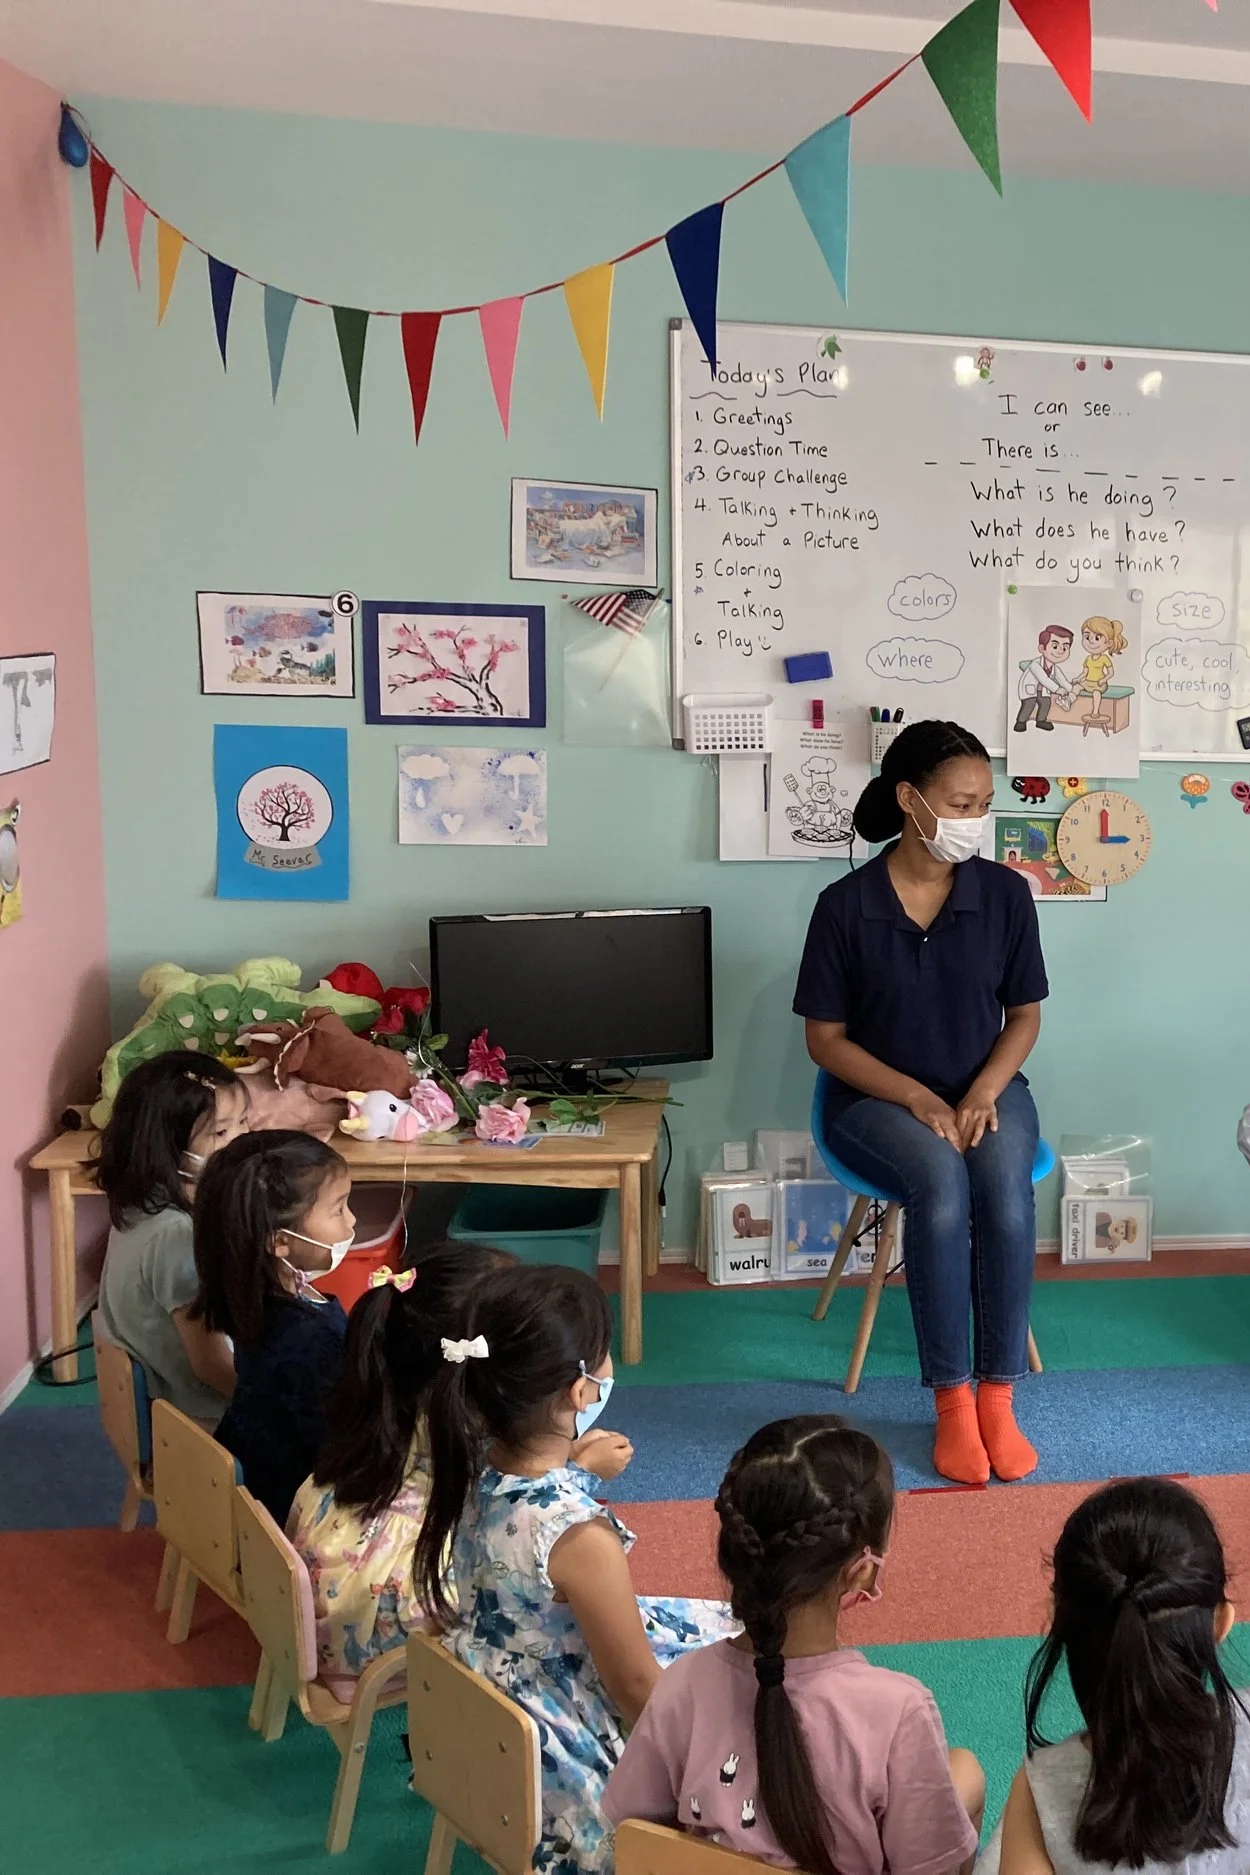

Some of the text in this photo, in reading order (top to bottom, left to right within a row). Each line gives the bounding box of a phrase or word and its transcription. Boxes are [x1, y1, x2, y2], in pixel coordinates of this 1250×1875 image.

[700, 359, 841, 398] Today's Plan
[997, 393, 1018, 415] I
[1034, 401, 1068, 415] can
[713, 406, 793, 436] Greetings
[1043, 422, 1061, 434] or
[693, 438, 828, 458] 2. Question Time
[981, 437, 1033, 458] There
[693, 465, 848, 493] 3. Group Challenge
[970, 479, 1026, 503] What
[1038, 486, 1054, 502] is
[1068, 484, 1088, 504] he
[694, 498, 711, 511] 4.
[718, 496, 778, 527] Talking
[801, 502, 879, 530] Thinking
[721, 529, 860, 550] About a Picture
[970, 518, 1024, 539] What
[1035, 520, 1075, 539] does
[1090, 522, 1110, 541] he
[714, 558, 782, 589] Coloring
[968, 548, 1025, 571] What
[1035, 549, 1059, 570] do
[1066, 557, 1103, 584] you
[337, 593, 354, 613] 6
[899, 587, 952, 606] colors
[717, 600, 784, 630] Talking
[1172, 603, 1212, 619] size
[717, 629, 753, 657] Play
[877, 648, 933, 668] where
[1155, 648, 1240, 675] cute, cool,
[251, 848, 266, 863] Mr
[1084, 865, 1089, 873] 7
[1102, 869, 1107, 878] 6
[1071, 1203, 1081, 1258] taxi driver
[730, 1255, 770, 1271] walru
[807, 1257, 827, 1267] sea
